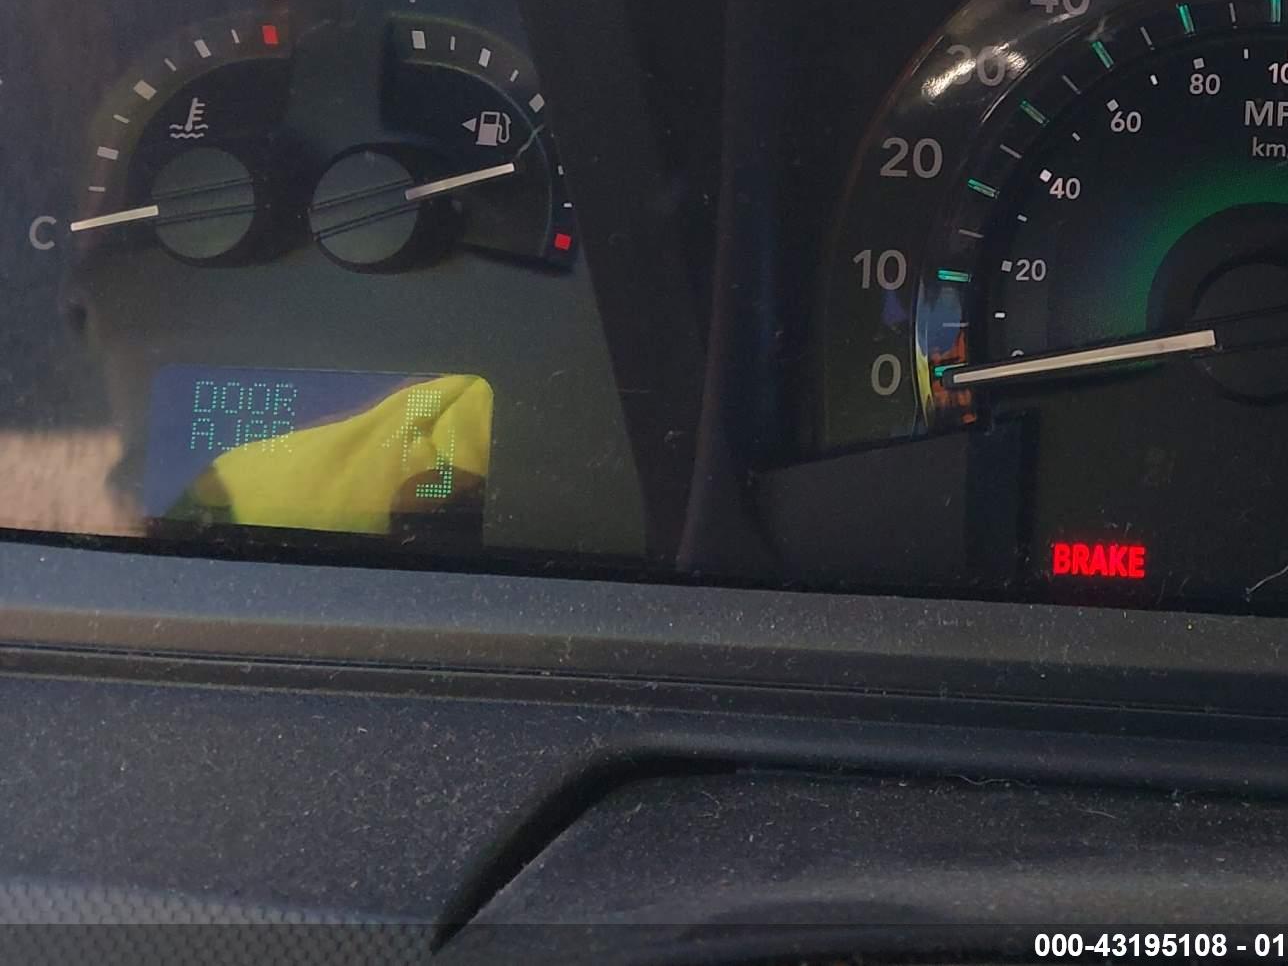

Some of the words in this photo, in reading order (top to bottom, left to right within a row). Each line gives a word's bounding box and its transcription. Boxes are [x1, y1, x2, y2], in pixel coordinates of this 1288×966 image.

[942, 44, 1006, 87] 30
[1190, 74, 1220, 94] 80
[1110, 112, 1142, 133] 60
[880, 138, 942, 178] 20
[1049, 178, 1081, 200] 40
[29, 216, 56, 250] C
[853, 249, 907, 290] 10
[1016, 260, 1045, 281] 20
[871, 354, 901, 395] 0
[193, 380, 298, 416] DOOR
[190, 418, 297, 453] AJAR
[1053, 543, 1145, 578] BRAKE
